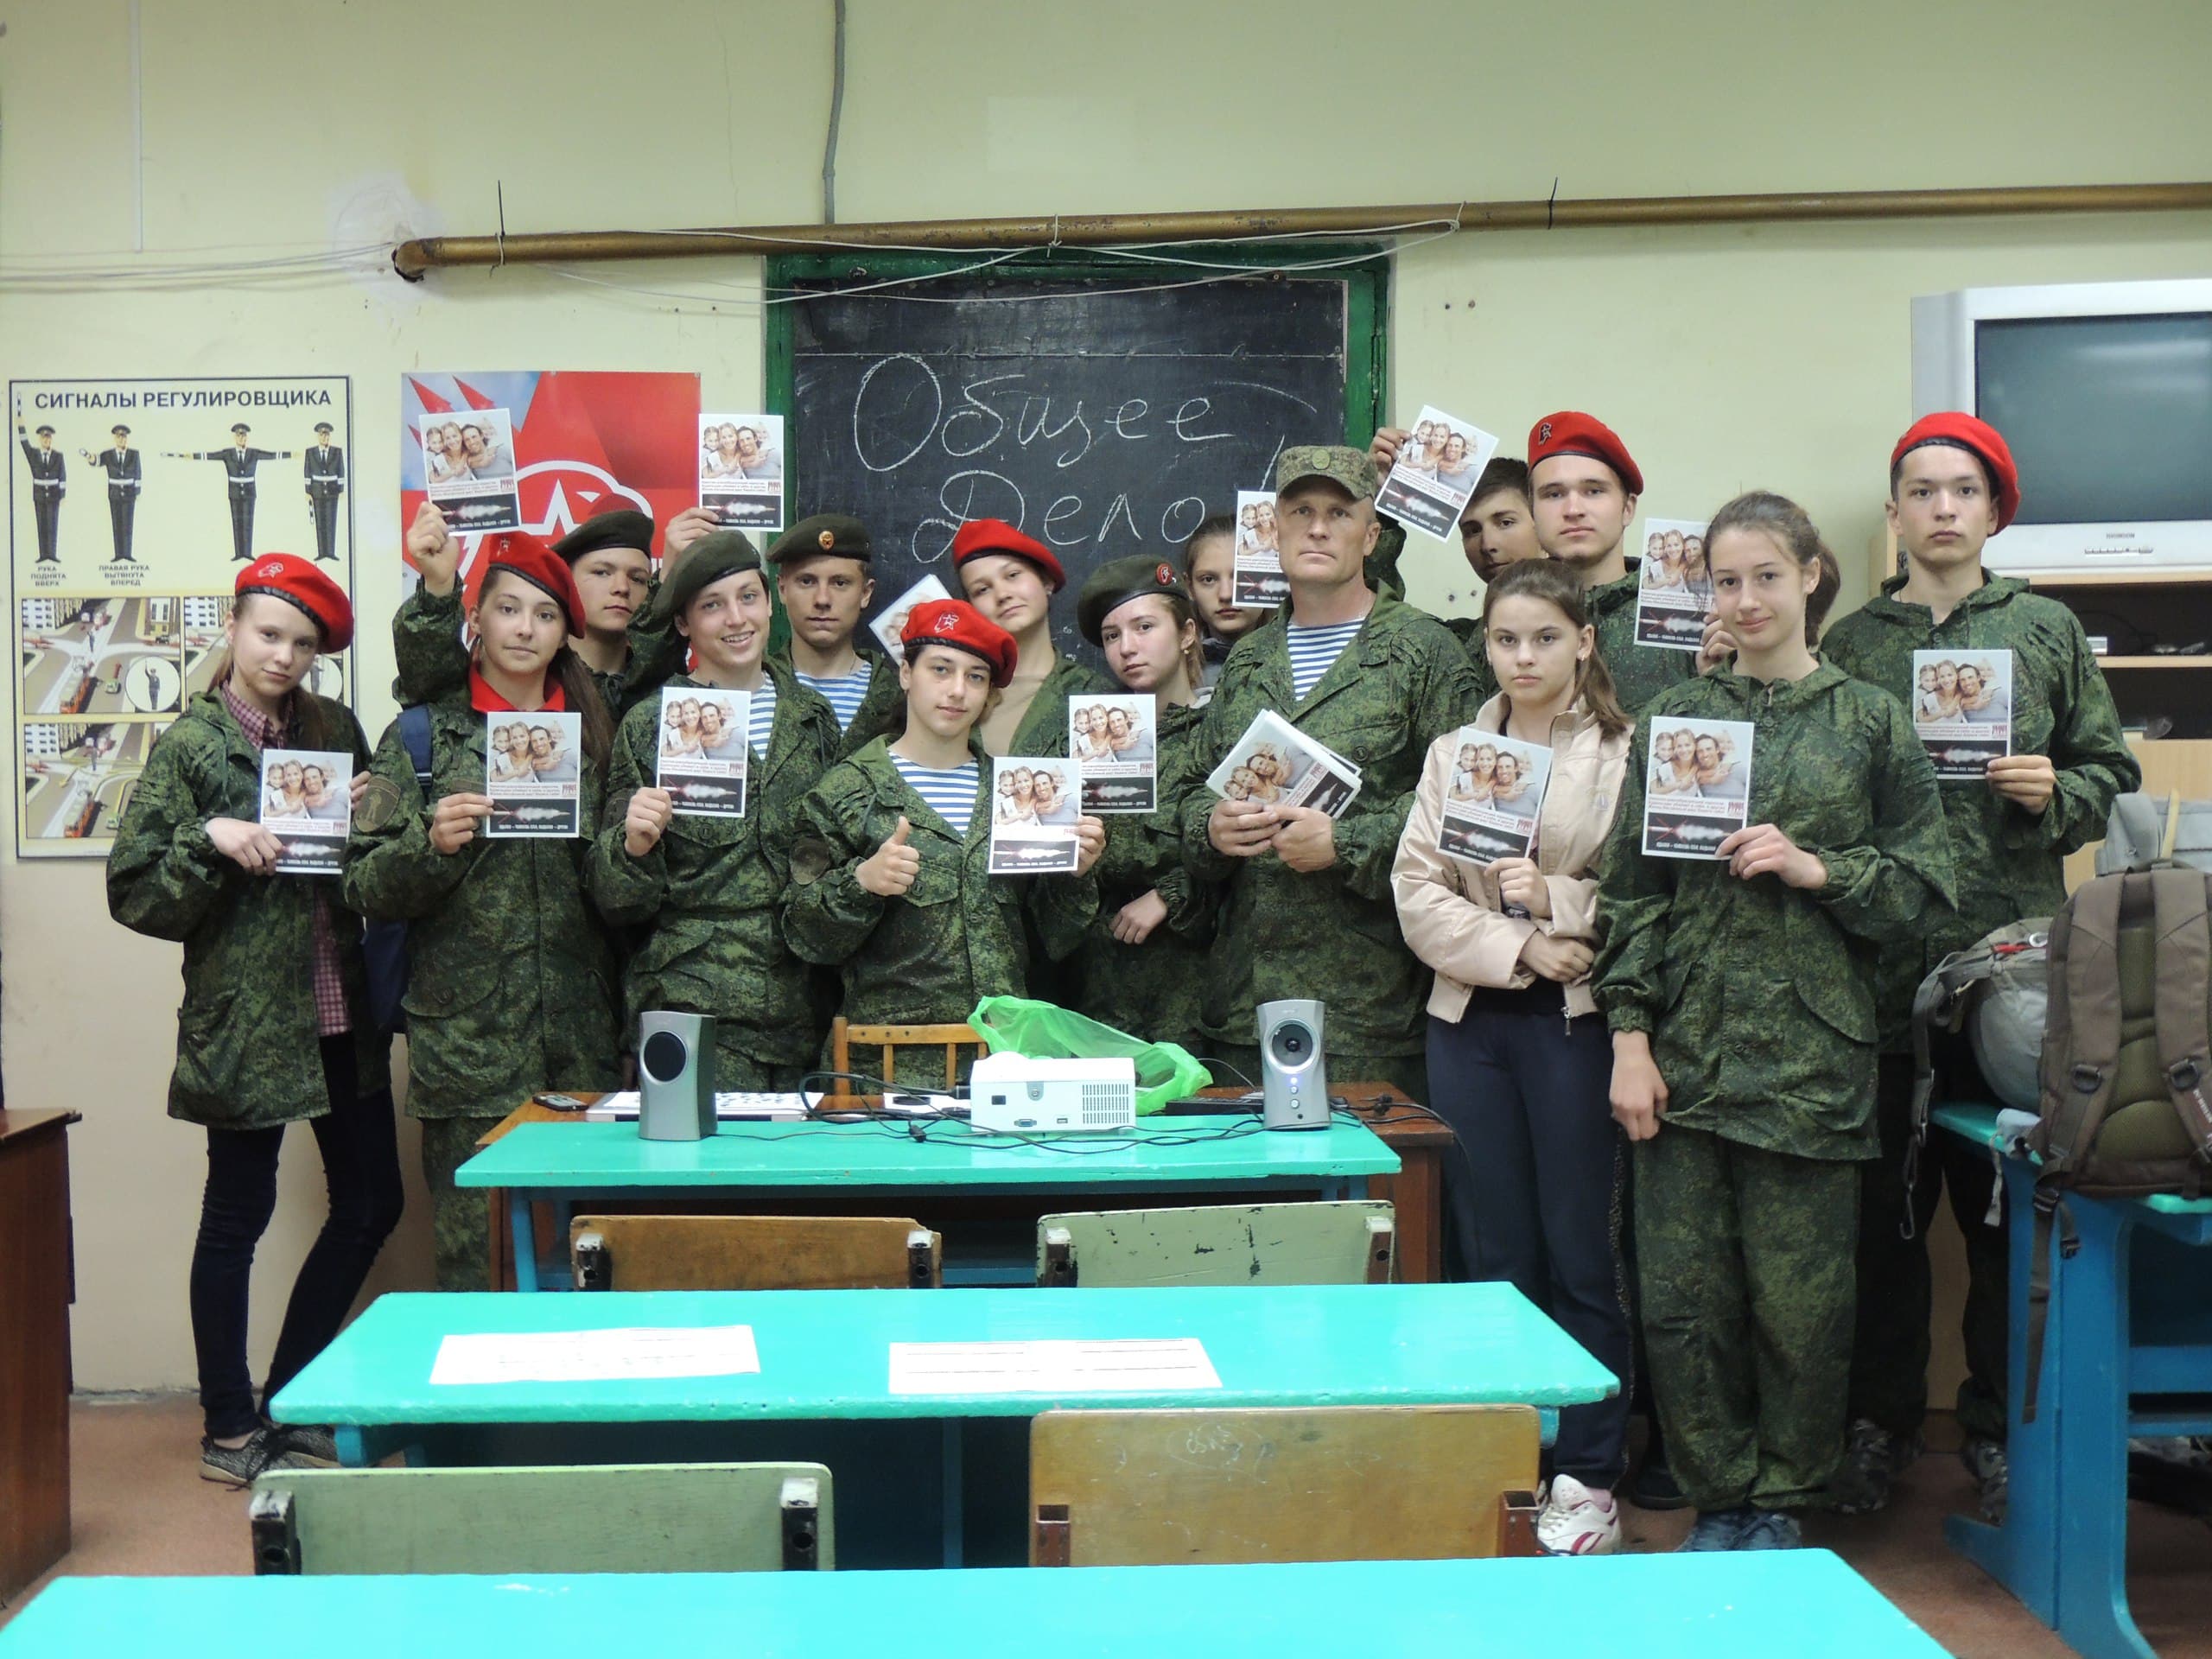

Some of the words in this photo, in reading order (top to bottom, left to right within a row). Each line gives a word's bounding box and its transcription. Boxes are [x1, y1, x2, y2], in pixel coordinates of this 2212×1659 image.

[35, 391, 137, 409] СИГНАЛЫ
[143, 390, 332, 409] РЕГУЛИРОВЩИКА
[853, 353, 1236, 472] Общее
[912, 468, 1206, 564] Дело
